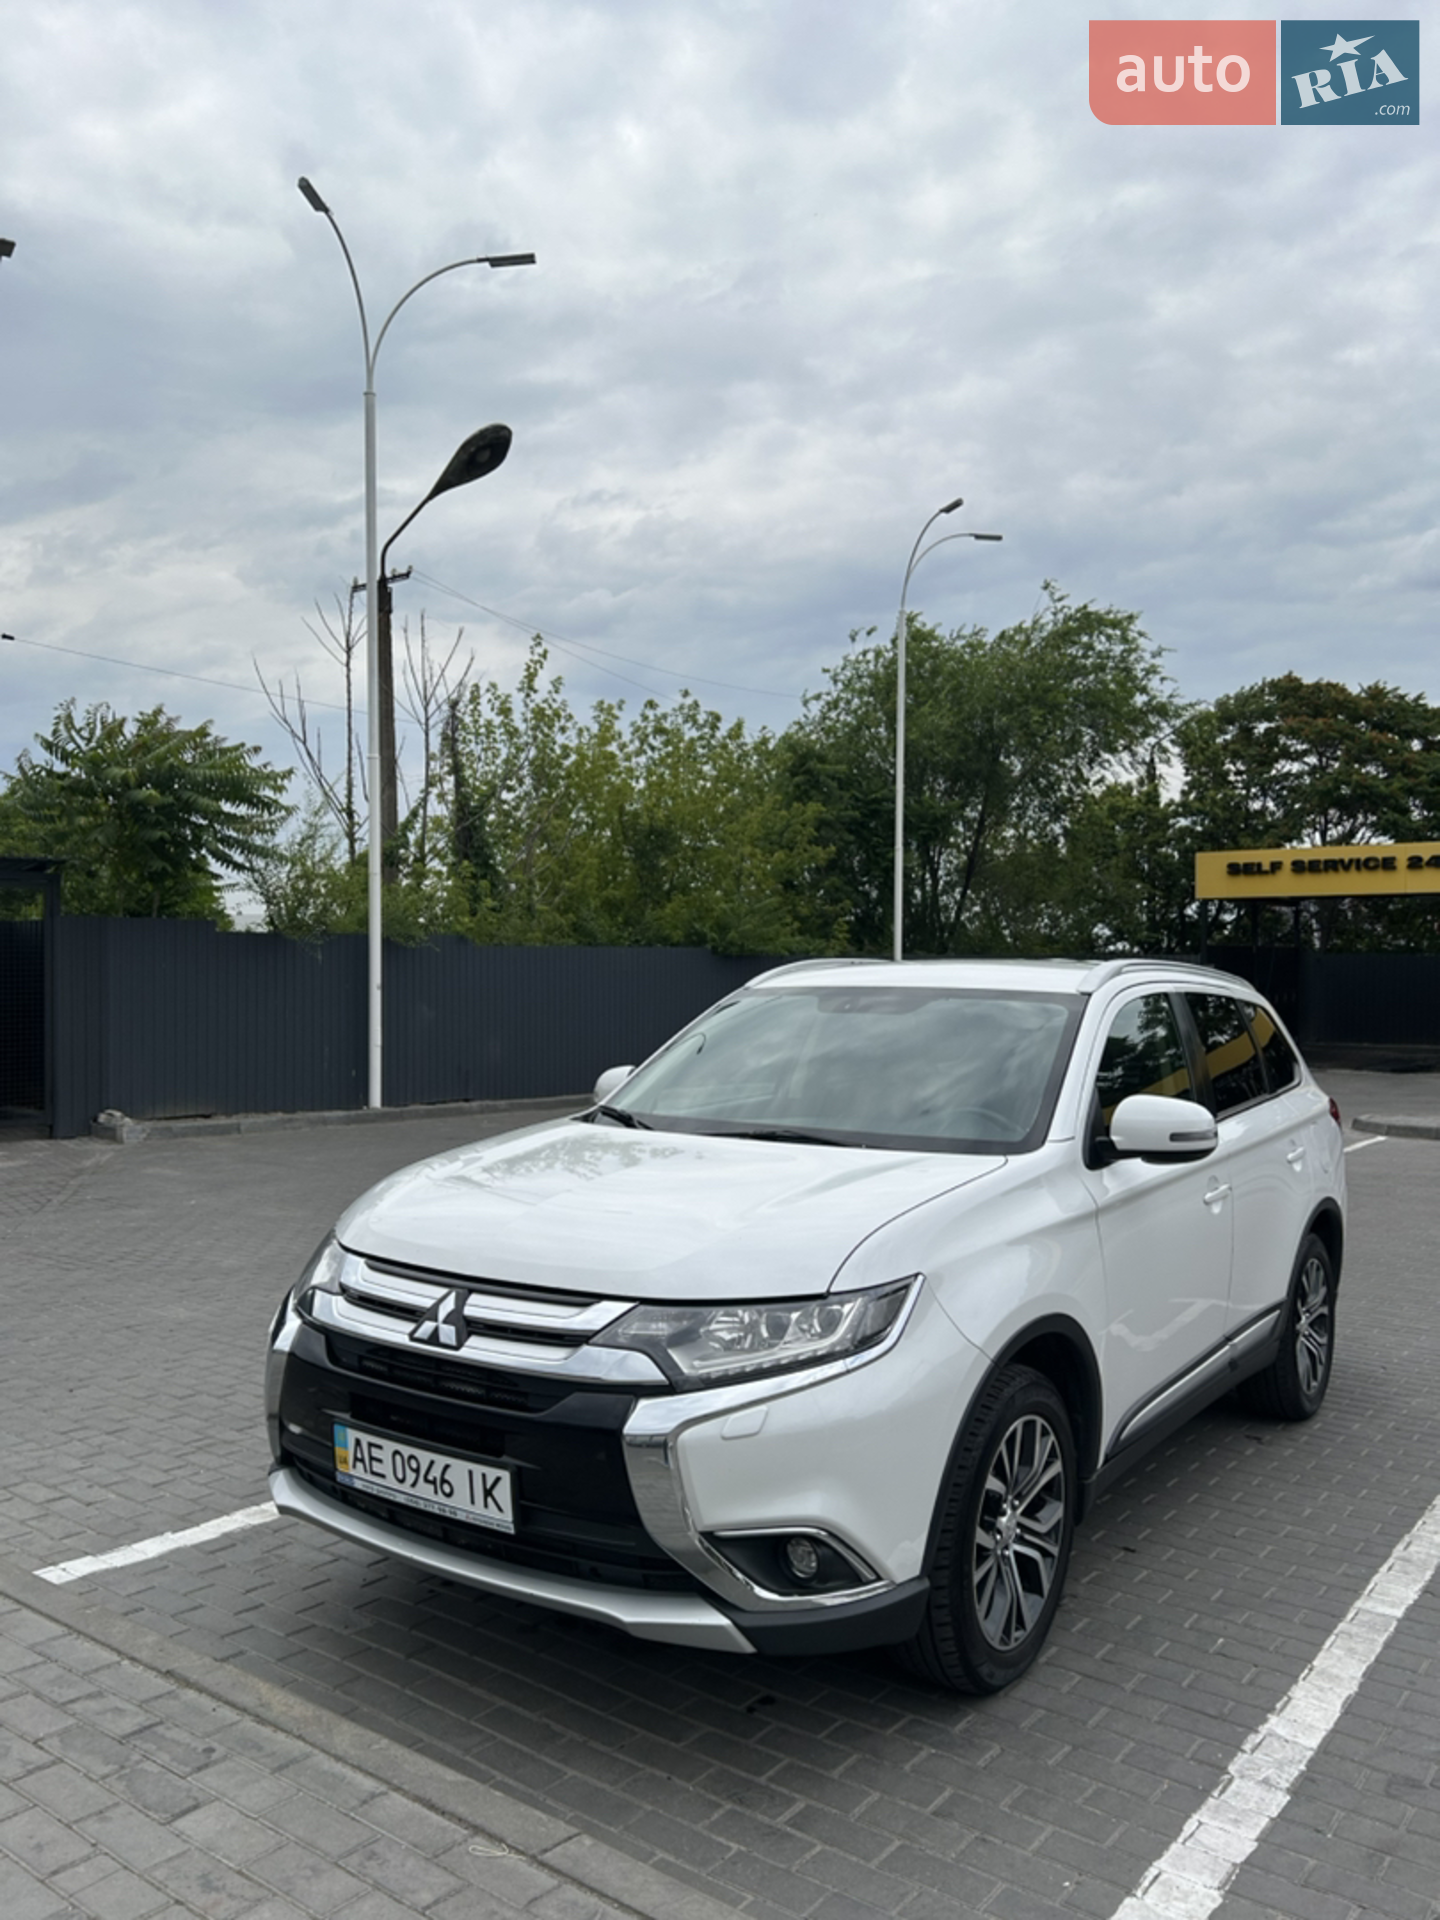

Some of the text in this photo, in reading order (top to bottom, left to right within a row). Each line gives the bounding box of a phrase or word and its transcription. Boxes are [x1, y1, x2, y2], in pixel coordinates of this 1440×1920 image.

[1226, 861, 1283, 876] SELF
[1290, 856, 1397, 874] SERVICE
[352, 1437, 387, 1479] AE
[391, 1449, 455, 1498] 0946
[467, 1468, 504, 1514] IK
